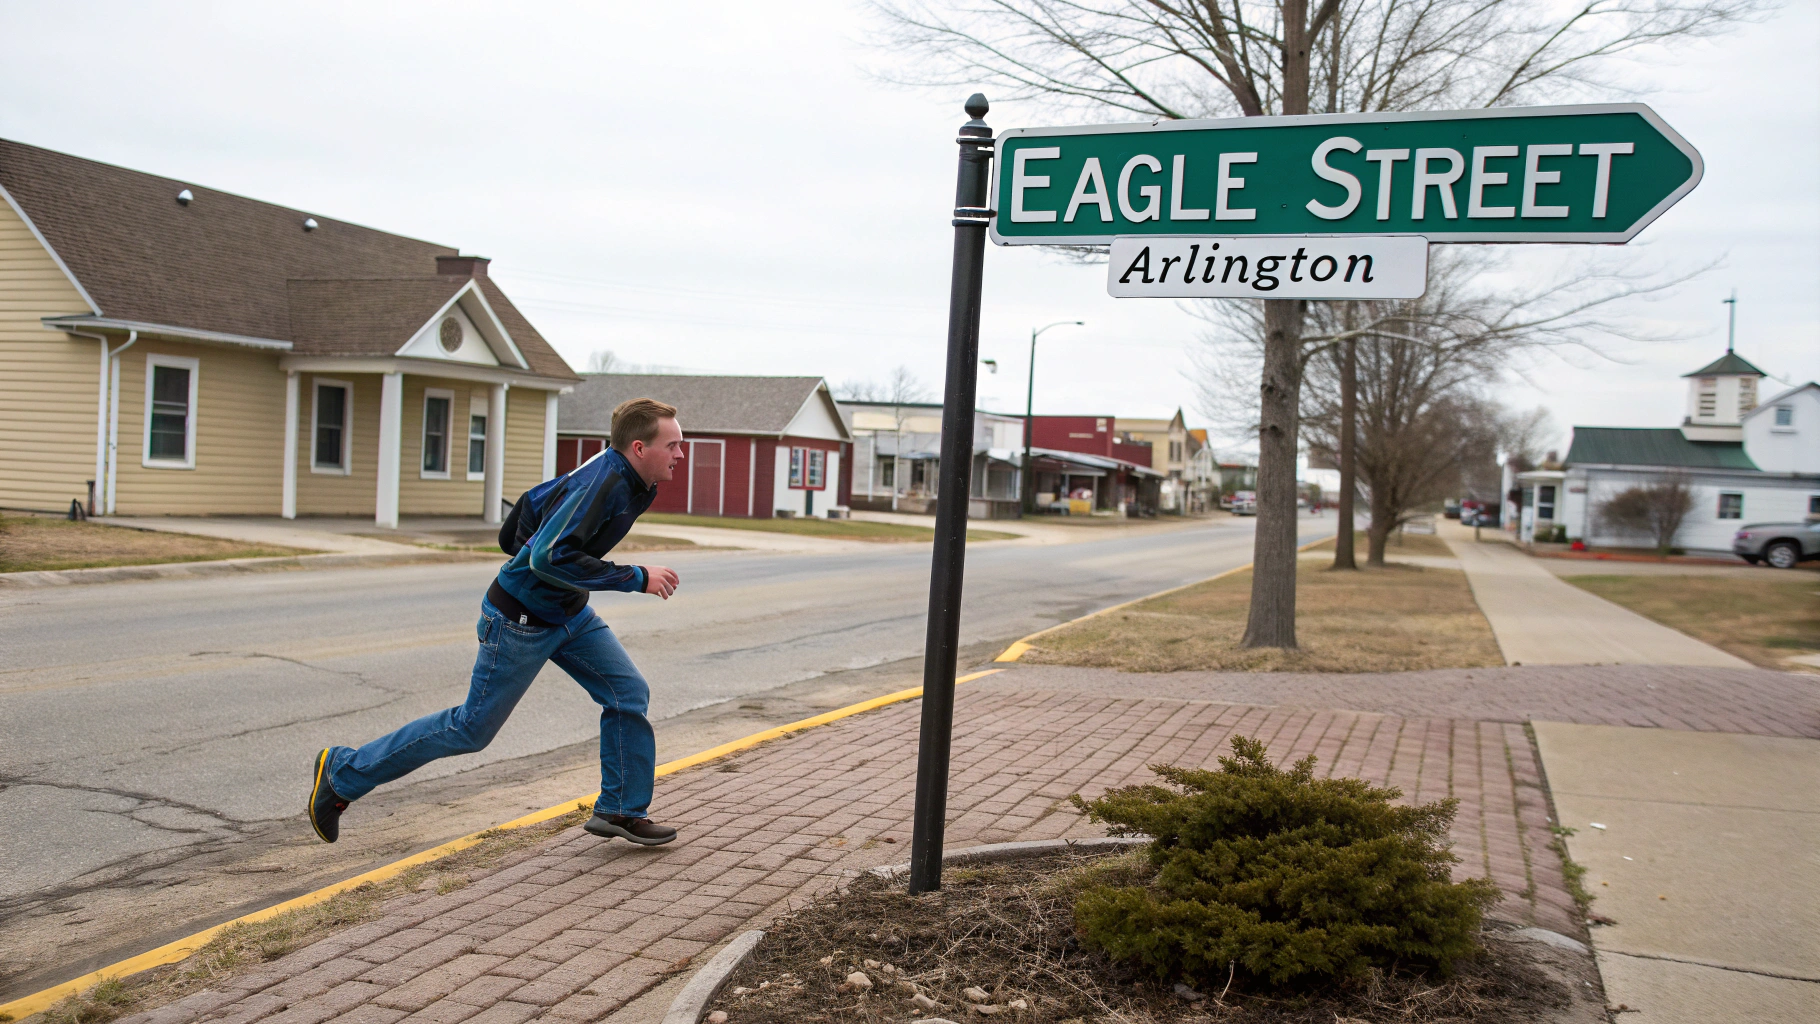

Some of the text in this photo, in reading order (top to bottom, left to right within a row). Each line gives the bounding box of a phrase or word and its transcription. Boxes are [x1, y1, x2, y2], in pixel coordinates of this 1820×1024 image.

[1010, 136, 1635, 223] EAGLE STREET
[1119, 242, 1375, 291] Arlington
